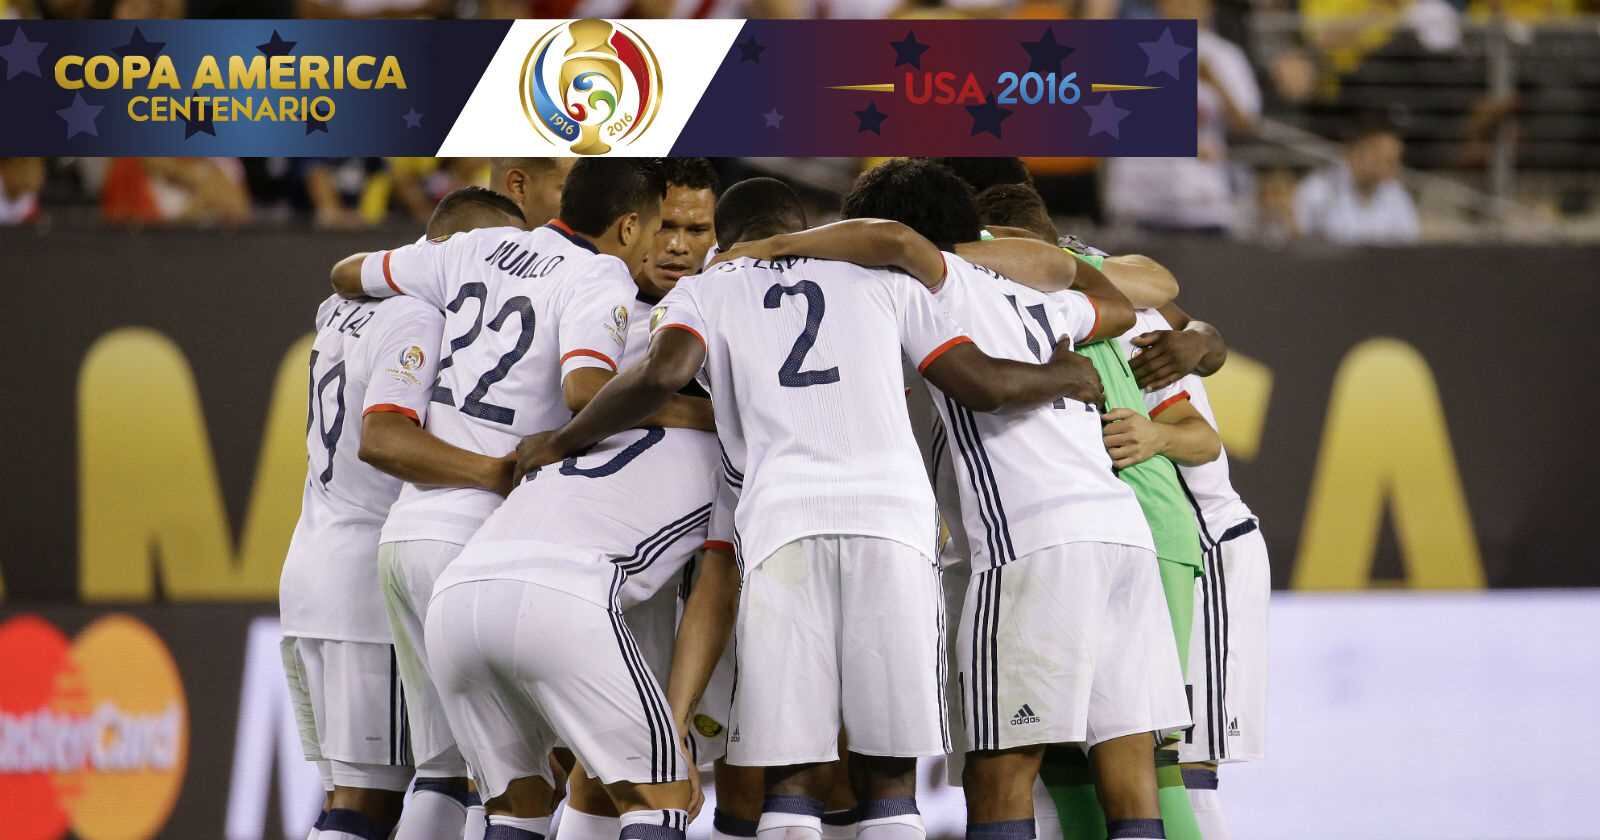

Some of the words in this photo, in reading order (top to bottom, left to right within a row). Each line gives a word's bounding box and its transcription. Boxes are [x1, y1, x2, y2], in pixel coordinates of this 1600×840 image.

[430, 281, 535, 426] 22
[763, 279, 841, 388] 2
[1010, 716, 1041, 726] adidas
